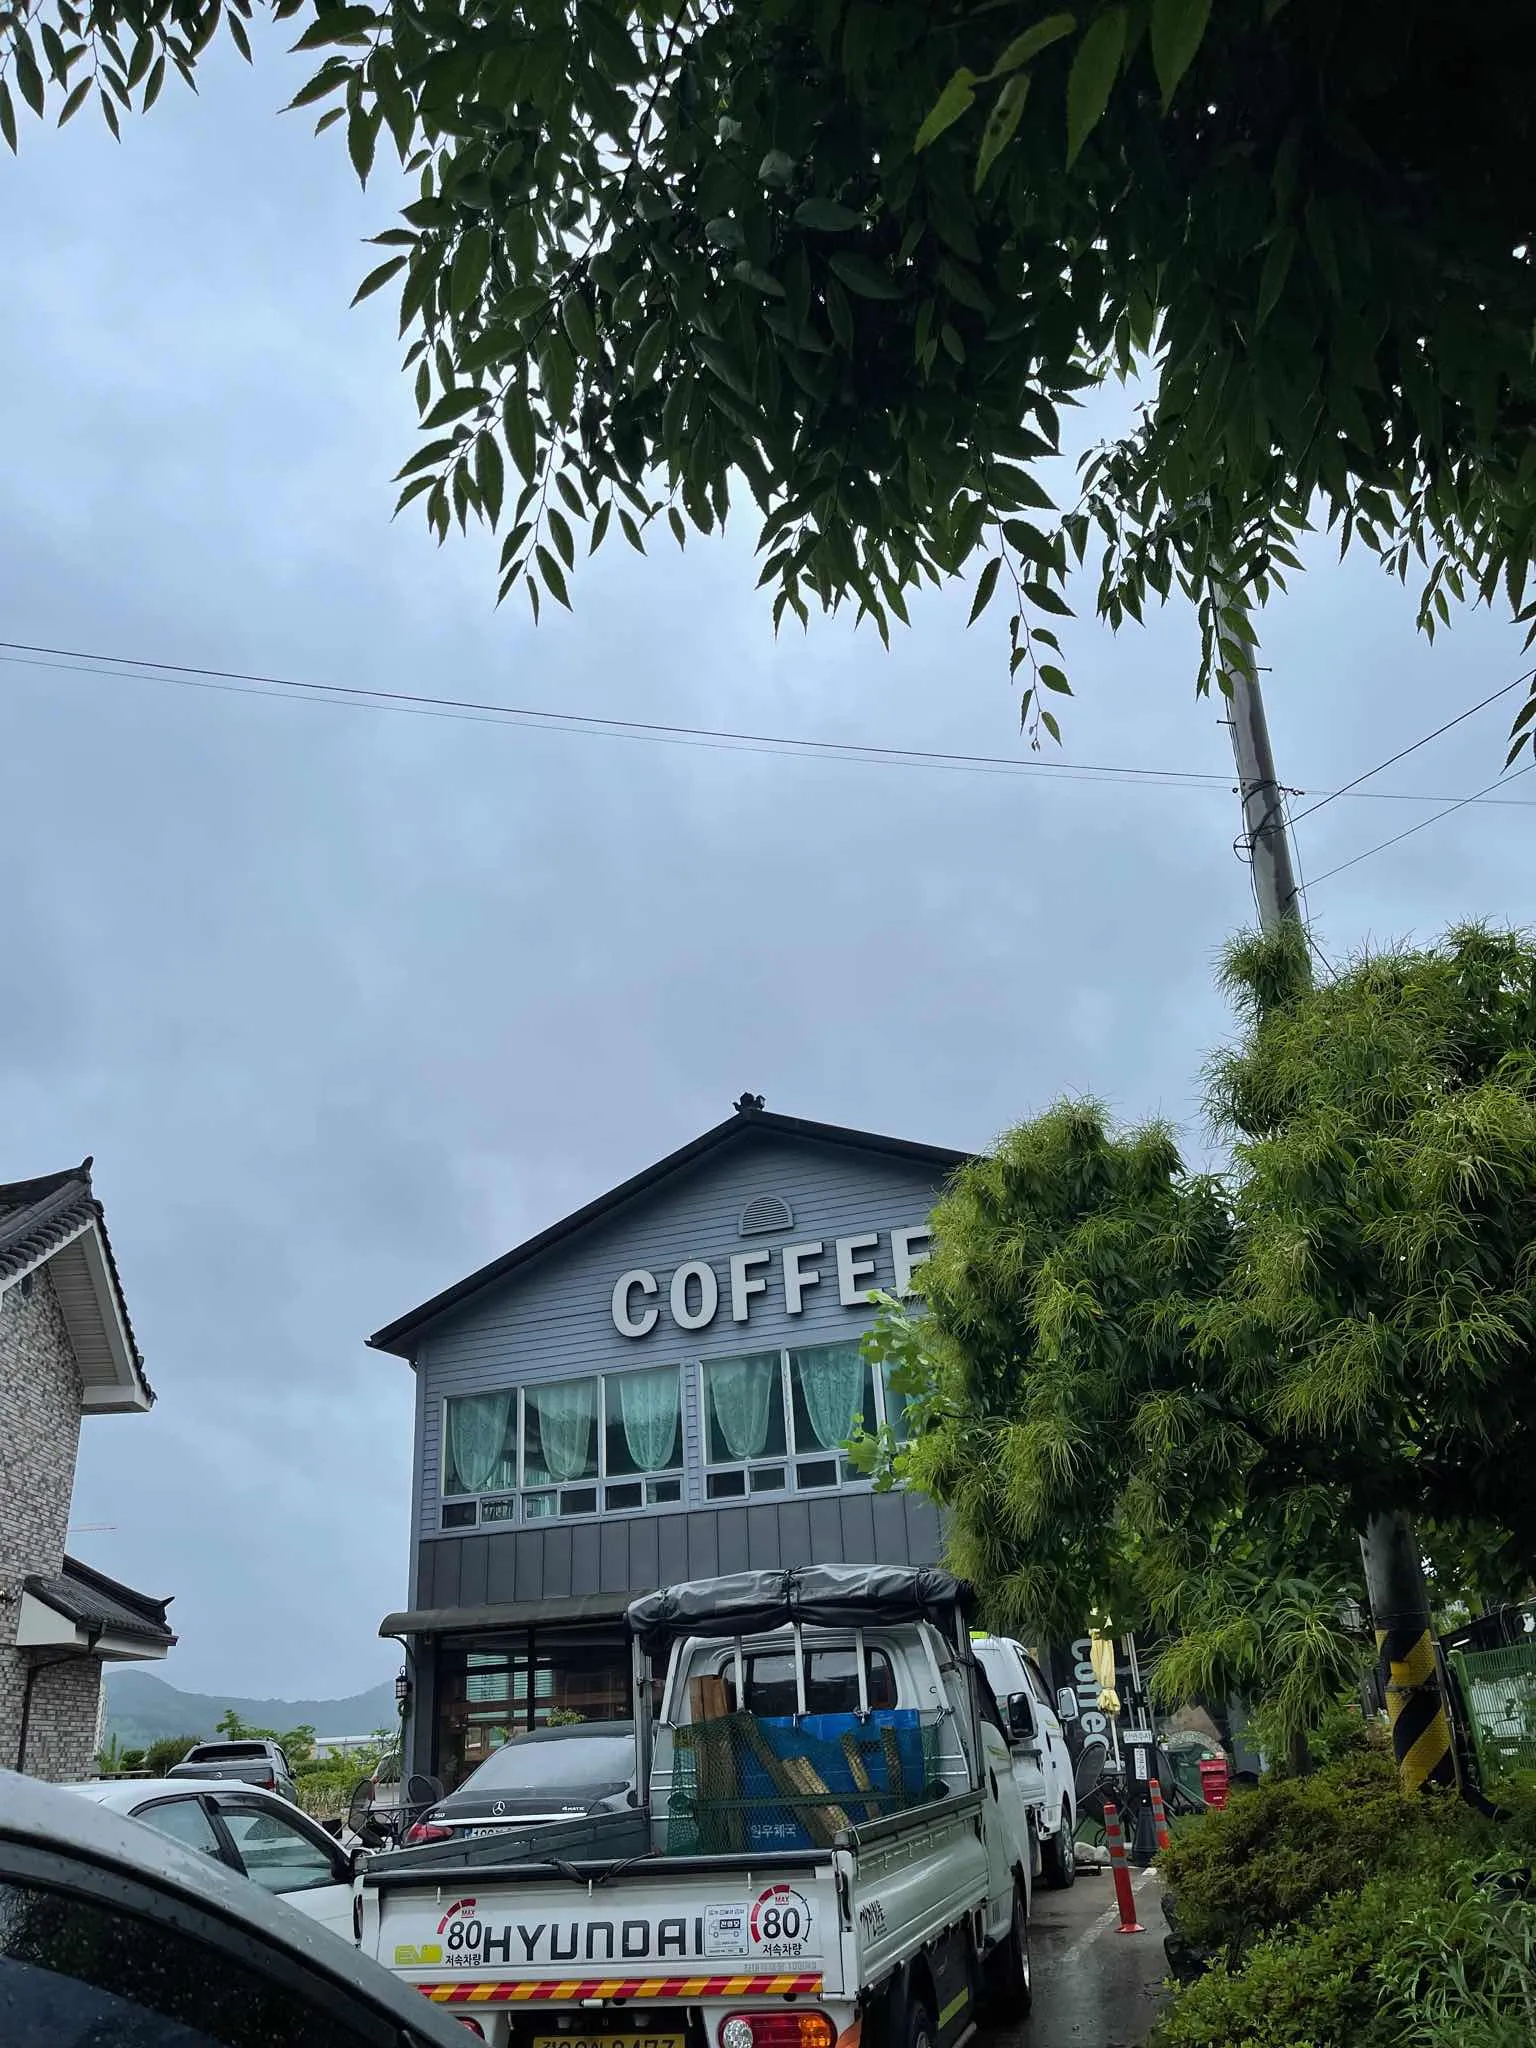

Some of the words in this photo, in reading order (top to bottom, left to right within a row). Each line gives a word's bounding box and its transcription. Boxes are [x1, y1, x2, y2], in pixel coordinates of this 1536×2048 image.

[611, 1225, 933, 1338] COFFEE
[775, 1896, 789, 1904] MAX
[447, 1920, 482, 1950] 80
[763, 1907, 800, 1939] 80
[482, 1916, 703, 1963] HYUNDAI
[762, 1943, 802, 1957] 저속차량
[445, 1952, 481, 1967] 저속차량
